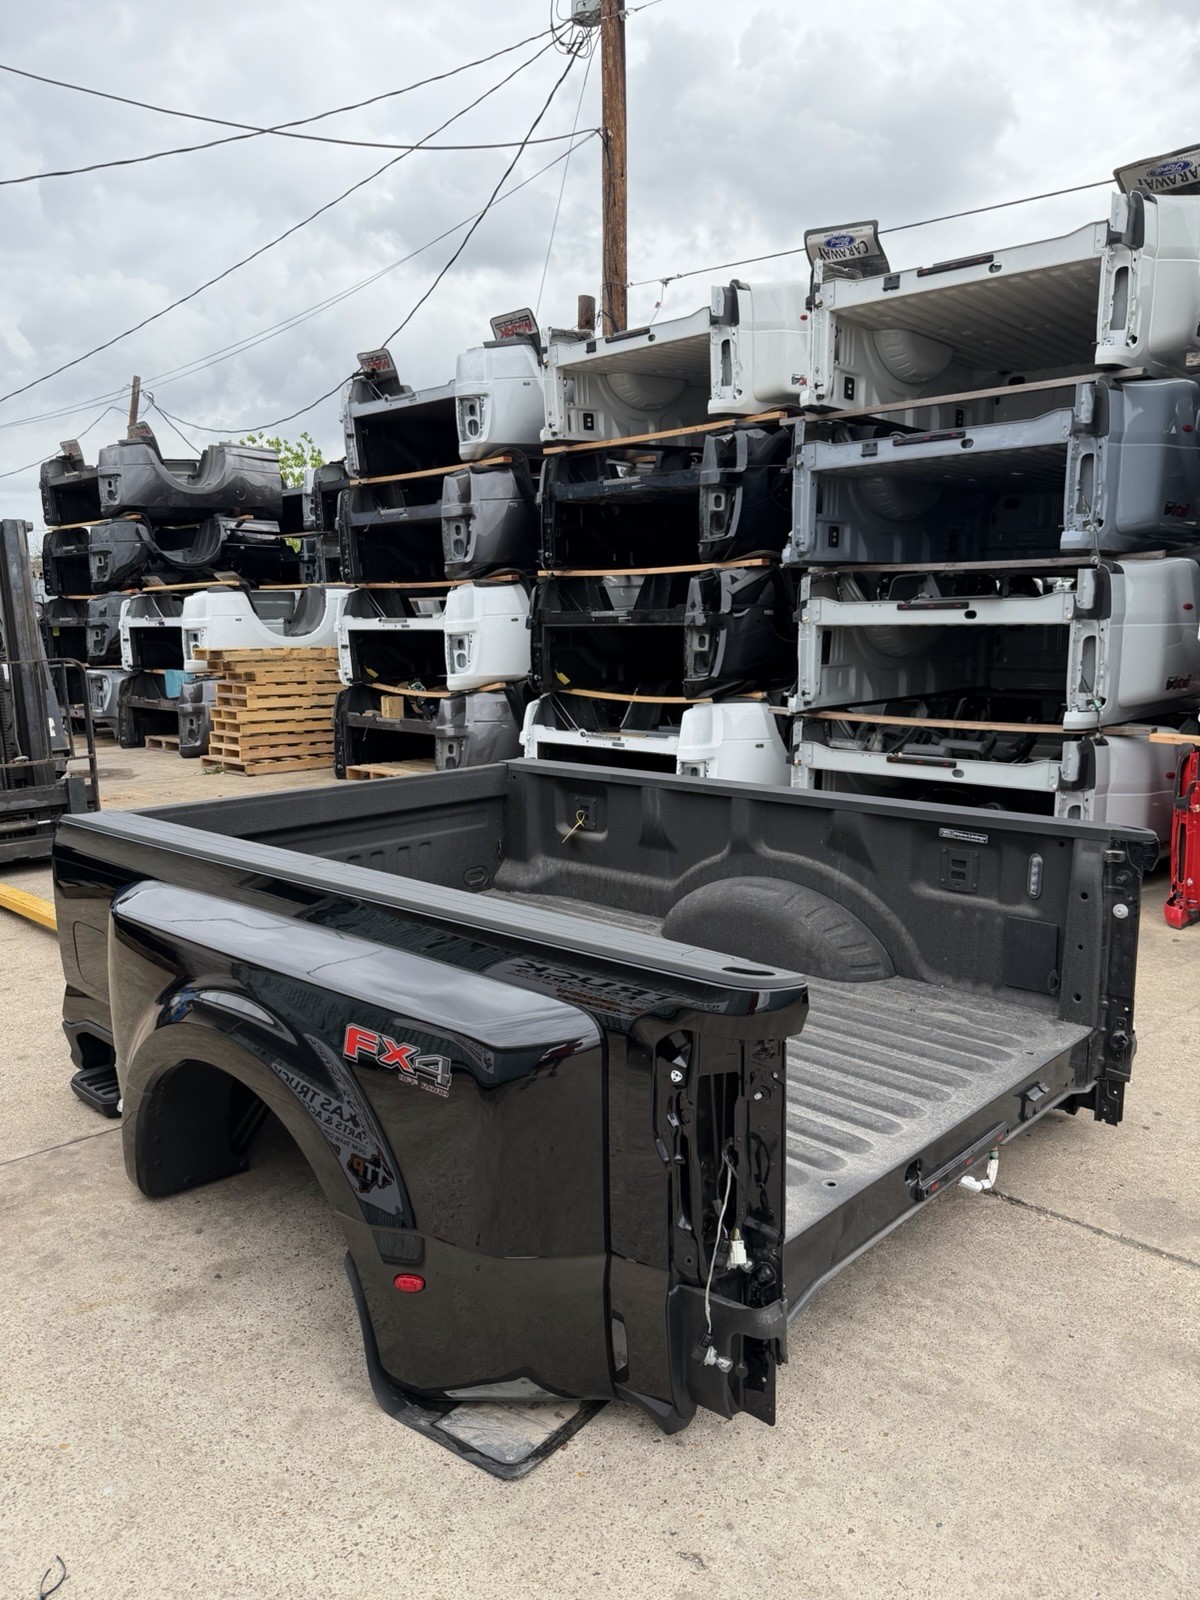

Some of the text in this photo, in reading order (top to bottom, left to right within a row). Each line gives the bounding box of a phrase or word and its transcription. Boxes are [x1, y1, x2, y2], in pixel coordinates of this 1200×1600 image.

[1153, 161, 1186, 176] Ford
[817, 240, 869, 261] CARAWAY
[828, 236, 852, 248] Ford
[343, 1022, 452, 1090] FX4
